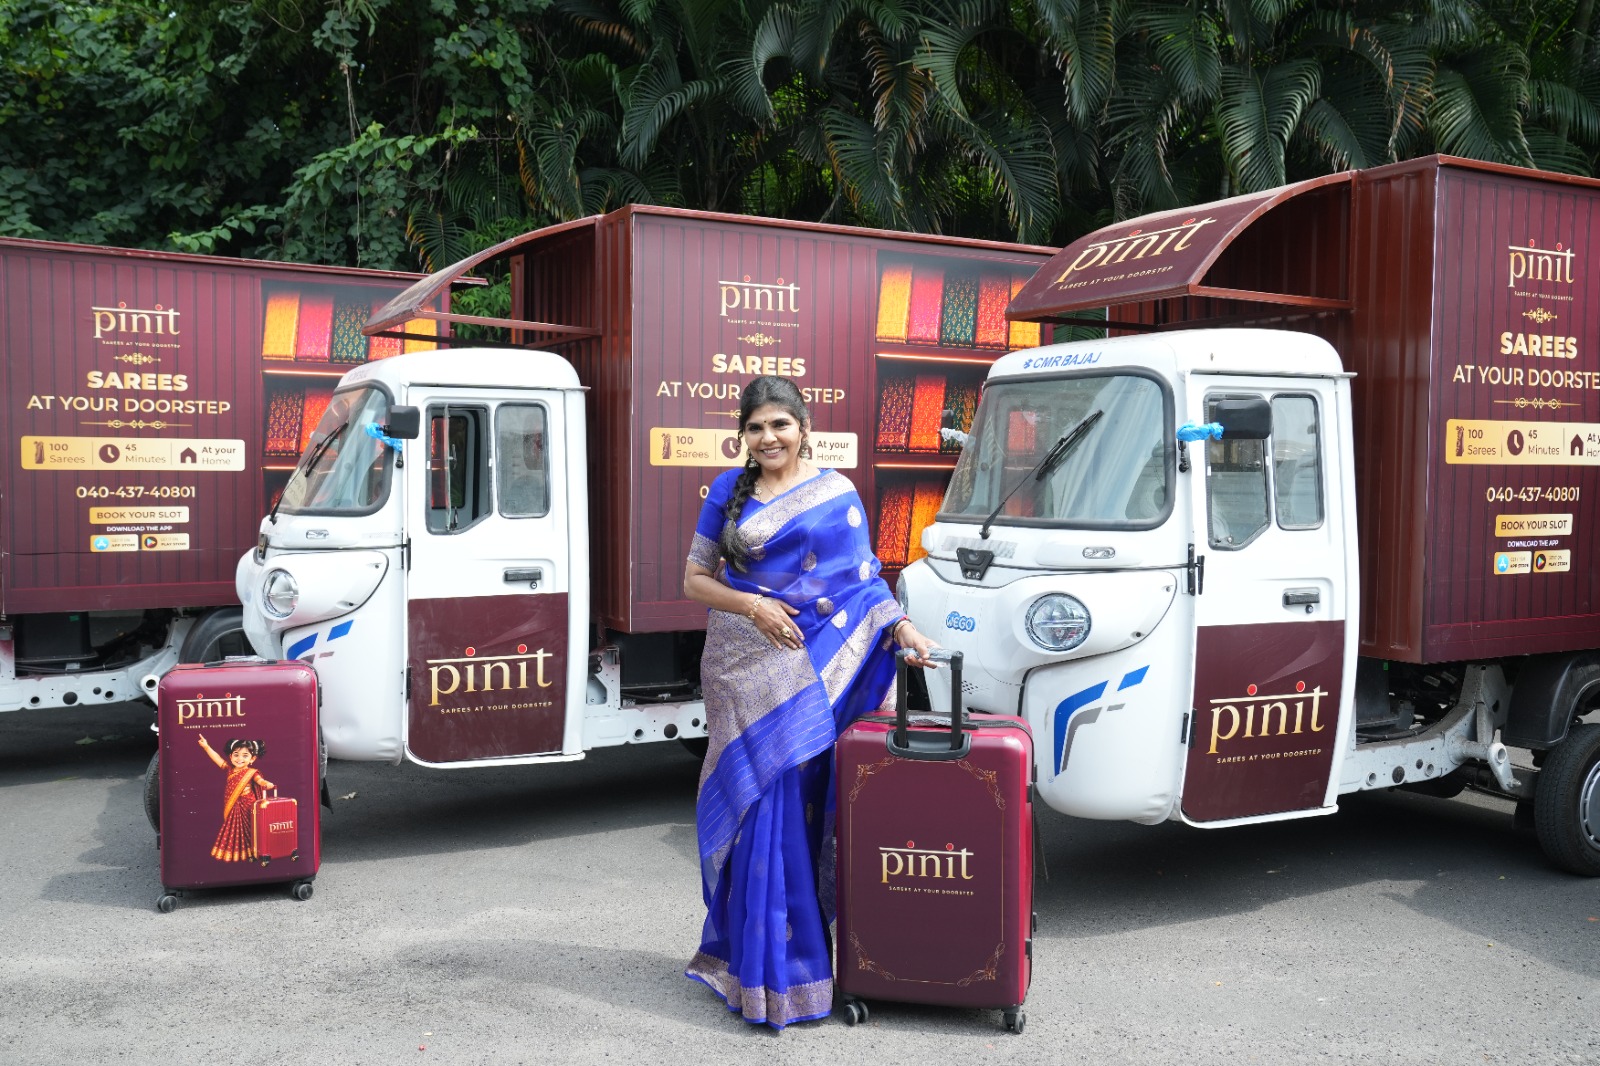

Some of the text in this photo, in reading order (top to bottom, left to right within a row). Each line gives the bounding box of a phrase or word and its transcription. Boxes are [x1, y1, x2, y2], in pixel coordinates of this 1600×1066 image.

[1054, 217, 1218, 284] pinit
[1508, 238, 1575, 288] pinit
[1058, 281, 1088, 290] SAREES
[1103, 275, 1125, 283] YOUR
[1127, 265, 1173, 279] DOORSTEP
[718, 275, 800, 316] pinit
[92, 301, 180, 339] pinit
[1500, 331, 1577, 359] SAREES
[712, 353, 806, 377] SAREES
[87, 370, 188, 392] SAREES
[1453, 365, 1600, 390] AT YOUR DOORSTE
[656, 381, 846, 404] AT YOUR STEP
[27, 395, 231, 415] AT YOUR DOORSTEP
[1468, 429, 1483, 439] 100
[1528, 429, 1538, 439] 45
[1587, 432, 1596, 443] At
[676, 436, 694, 445] 100
[817, 440, 850, 452] At your
[49, 443, 69, 452] 100
[125, 443, 137, 452] 45
[201, 446, 236, 456] At your
[1467, 444, 1497, 456] Sarees
[1528, 444, 1560, 456] Minutes
[1587, 447, 1600, 458] Ho
[49, 454, 86, 464] Sarees
[125, 454, 166, 464] Minutes
[676, 449, 709, 459] Sarees
[816, 453, 844, 462] Home
[201, 457, 231, 465] Home
[76, 485, 196, 498] 040-437-40801
[1486, 486, 1580, 502] 040-437-40801
[97, 511, 126, 519] BOOK
[128, 511, 155, 519] YOUR
[1501, 519, 1568, 530] BOOK YOUR SLOT
[1507, 540, 1538, 548] DOWNLOAD
[426, 644, 553, 706] pinit
[176, 692, 246, 725] pinit
[511, 701, 553, 709] DOORSTEP
[1206, 680, 1329, 754] pinit
[1217, 755, 1246, 764] SAREES
[1261, 752, 1281, 760] YOUR
[1283, 748, 1322, 758] DOORSTEP
[879, 840, 974, 884] pinit
